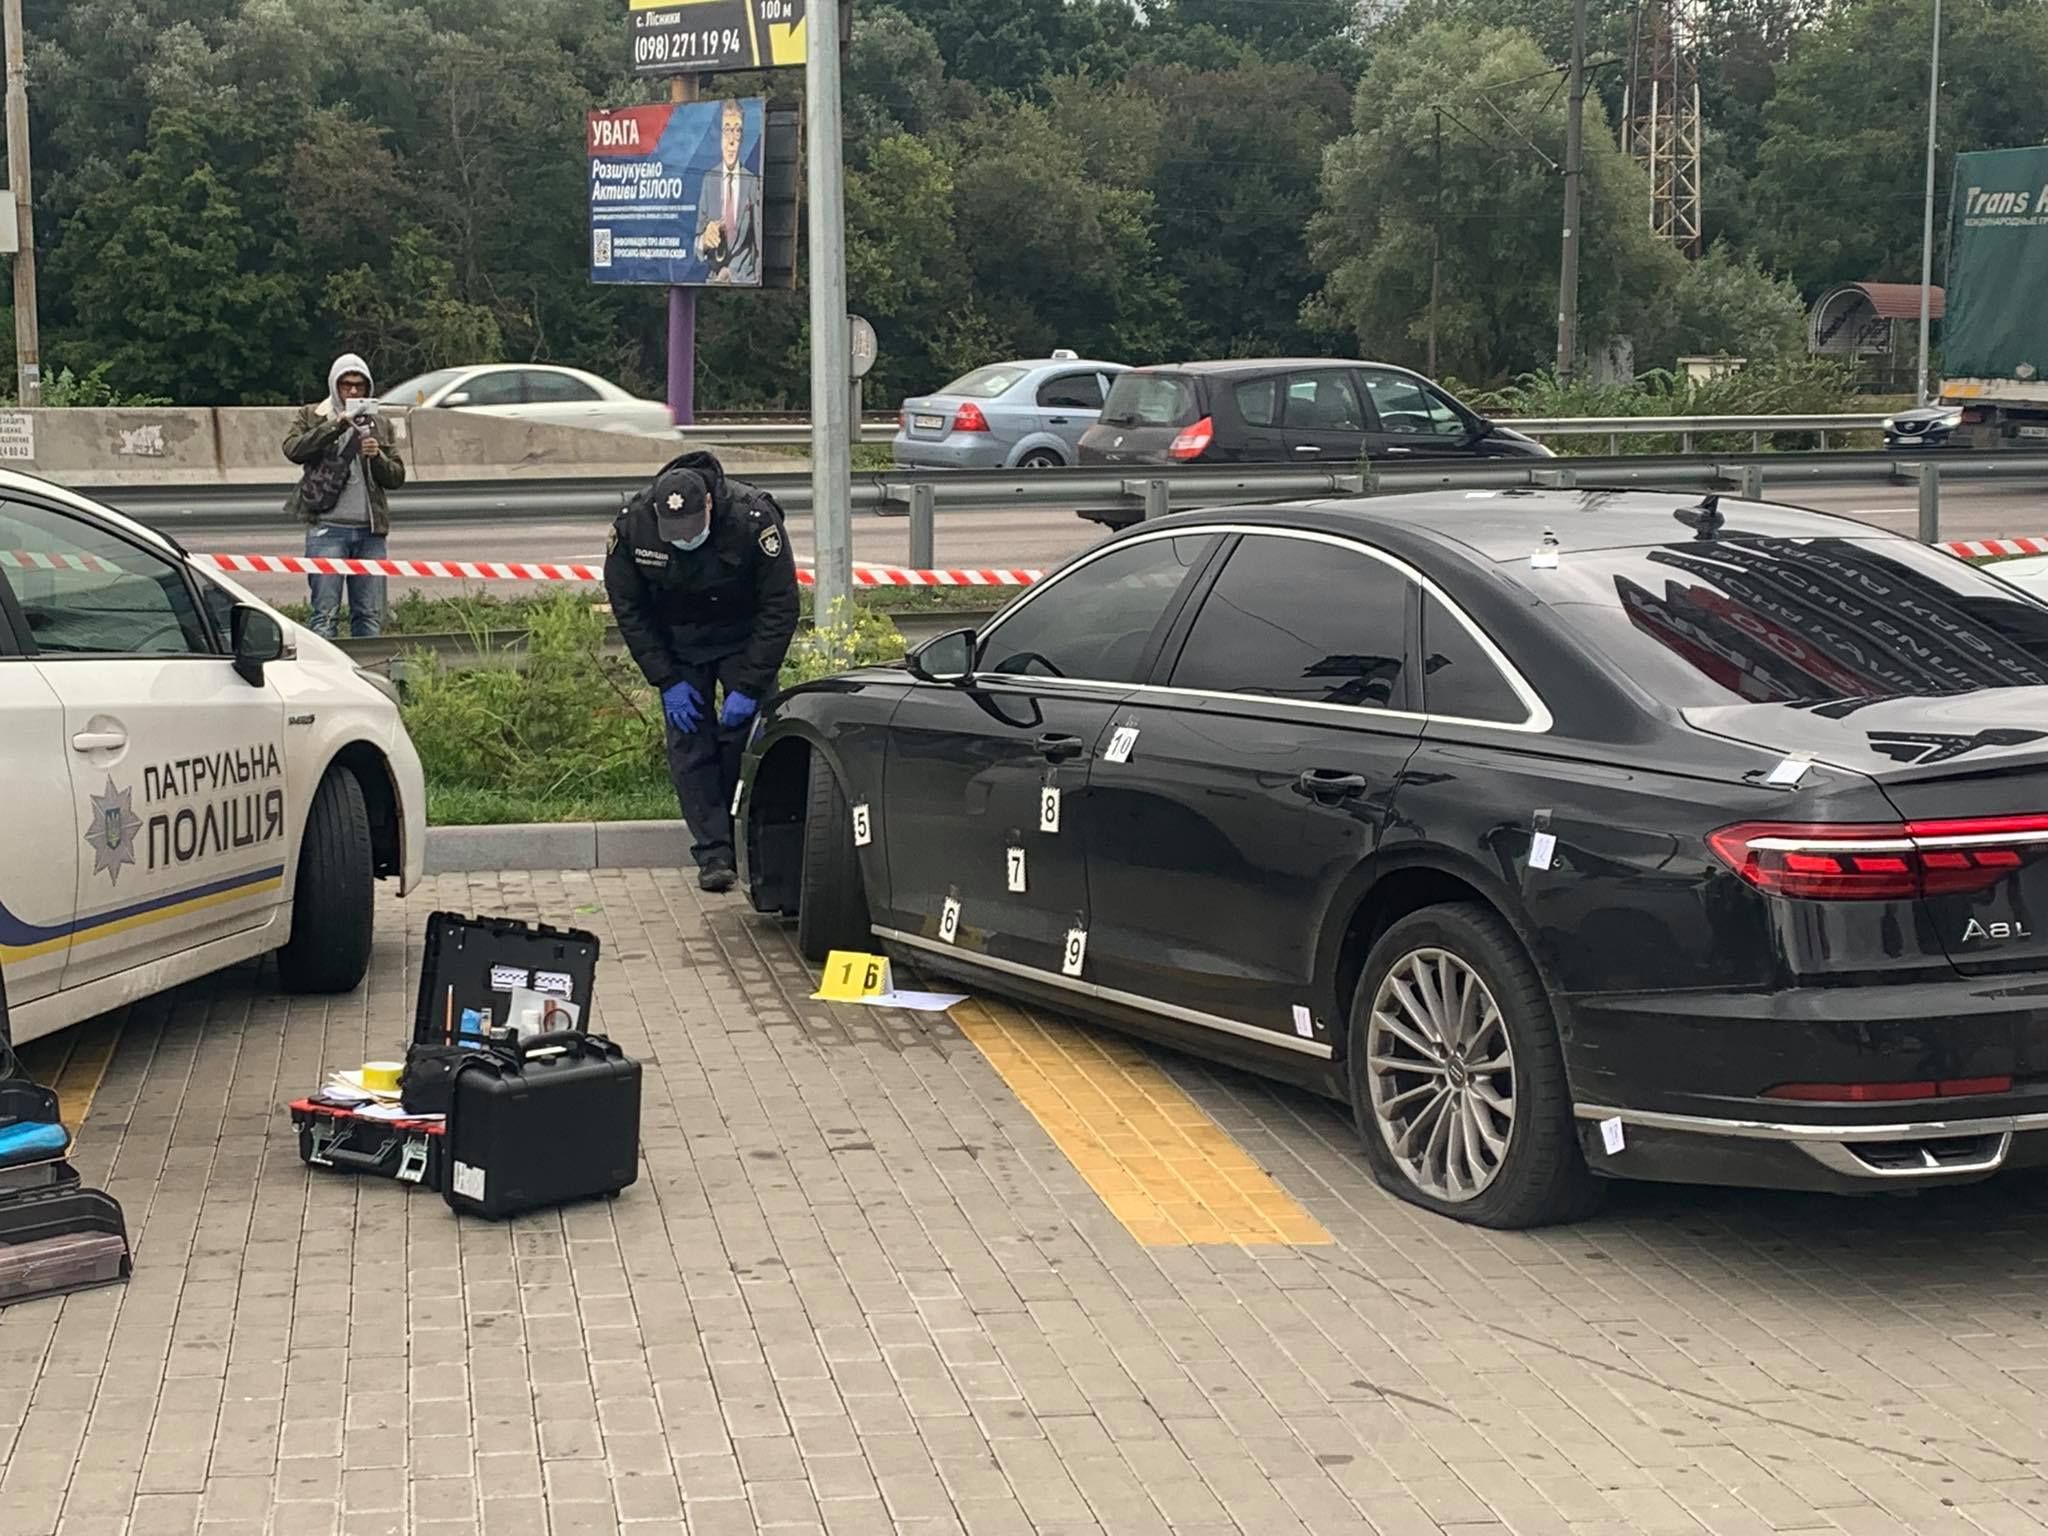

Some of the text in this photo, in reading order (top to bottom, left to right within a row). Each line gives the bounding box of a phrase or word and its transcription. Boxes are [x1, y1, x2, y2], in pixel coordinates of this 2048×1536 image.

[760, 0, 780, 19] 100
[635, 28, 740, 63] (098) 271 19 94
[592, 119, 640, 146] УВАГА
[592, 159, 663, 184] Розшукуємо
[592, 178, 683, 201] Активи БІЛОГО
[1967, 186, 2030, 214] Trans
[1114, 732, 1132, 755] 10
[144, 743, 282, 802] ПАТРУЛЬНА
[1045, 795, 1056, 822] 8
[148, 789, 283, 870] ПОЛІЦІЯ
[857, 812, 867, 838] 5
[1011, 856, 1021, 885] 7
[944, 907, 955, 934] 6
[1069, 937, 1080, 966] 9
